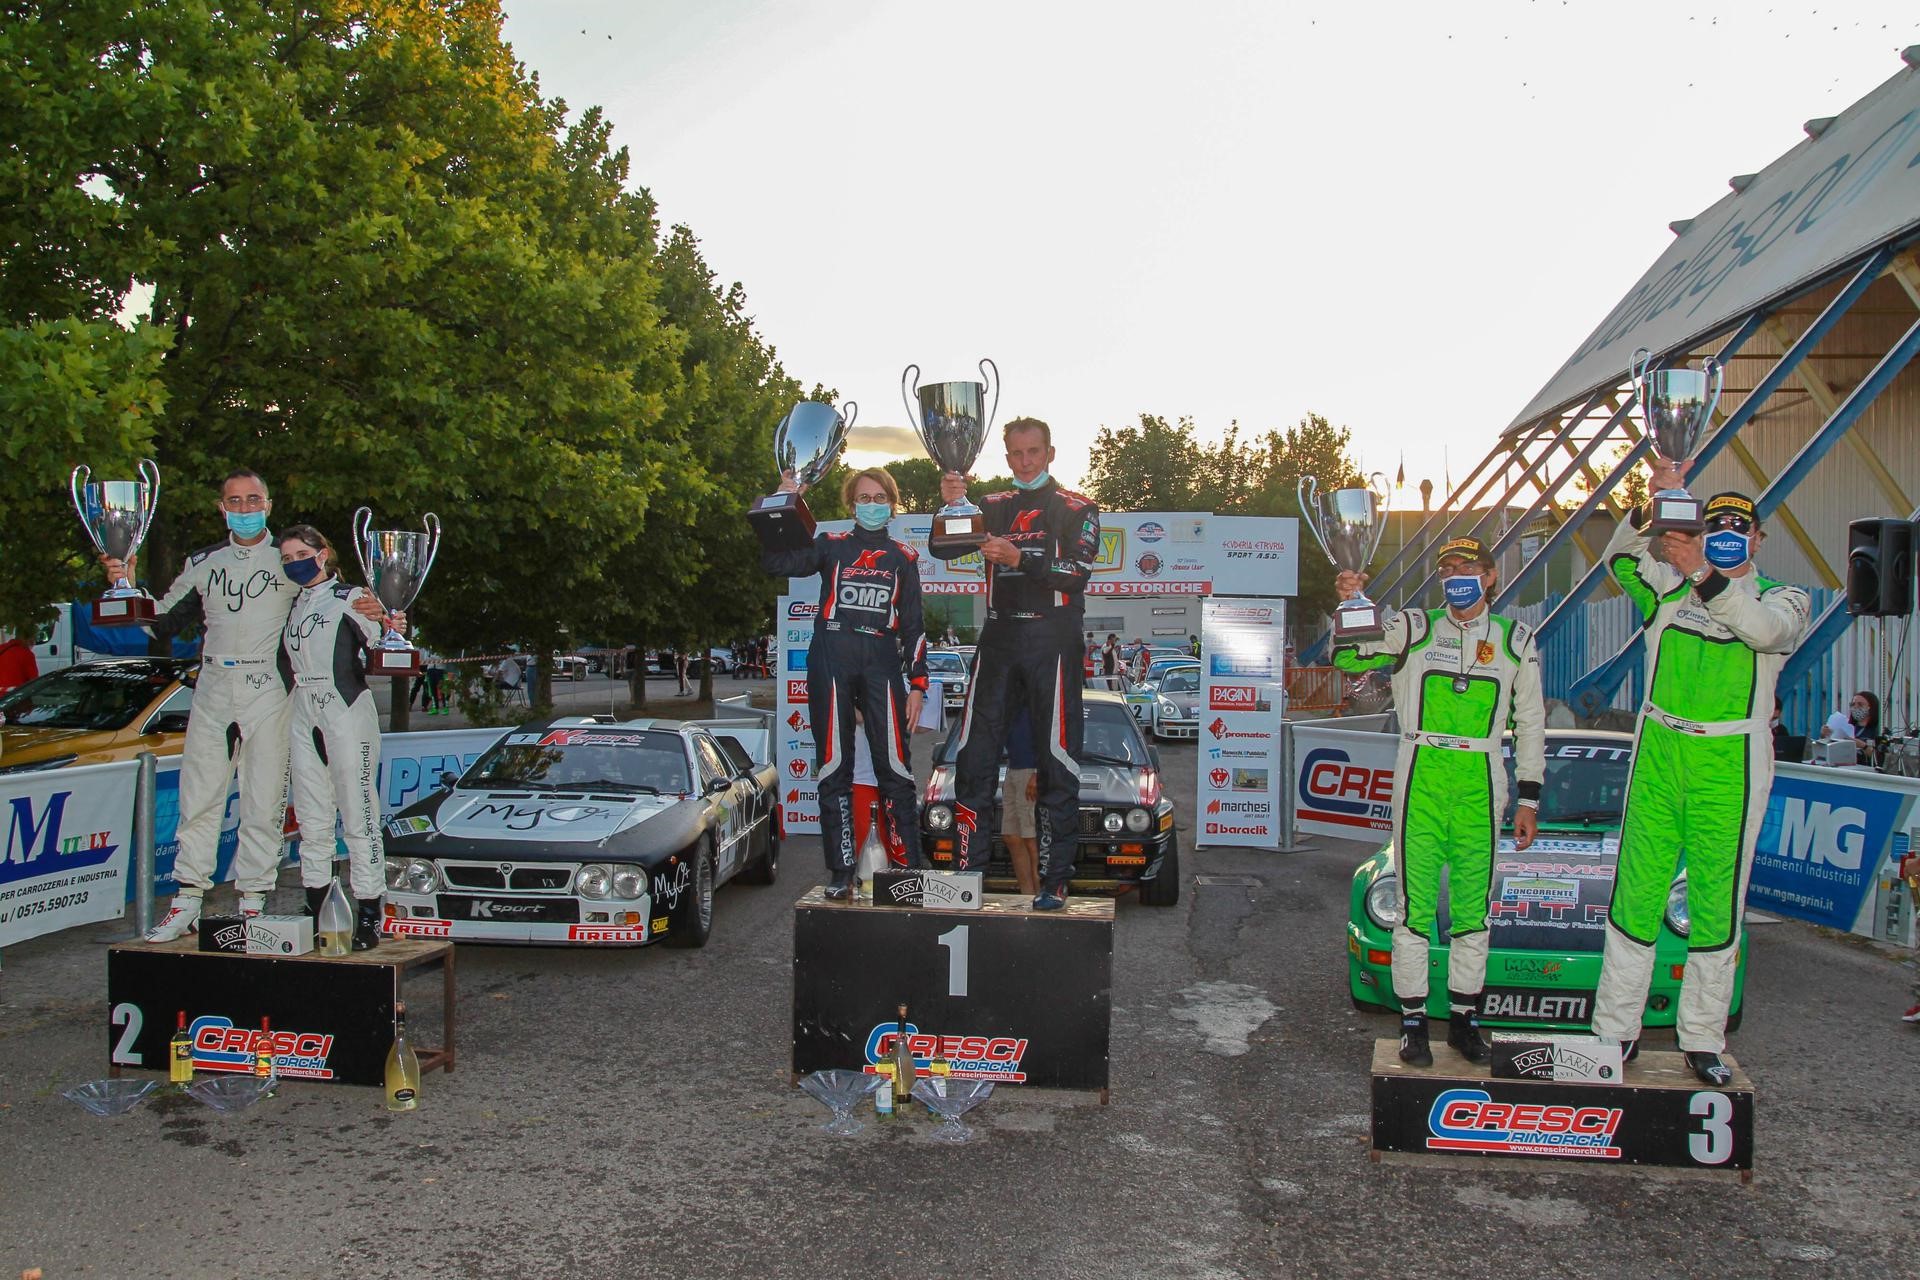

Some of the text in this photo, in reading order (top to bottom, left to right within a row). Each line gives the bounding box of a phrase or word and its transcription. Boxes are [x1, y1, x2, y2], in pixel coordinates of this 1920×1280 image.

[840, 585, 890, 608] OMP
[919, 583, 979, 593] ONATO
[1081, 582, 1203, 594] UTO STORICHE
[1213, 687, 1252, 702] PAGANI
[1134, 705, 1142, 719] 2
[1221, 801, 1270, 813] marchesi
[838, 795, 855, 866] RANGERS
[1220, 824, 1268, 835] baraclit
[1778, 796, 1868, 870] MG
[1755, 855, 1862, 887] edamenti Industriali
[17, 882, 69, 897] CARROZZERIA
[78, 869, 118, 884] INDUSTRIA
[891, 881, 915, 899] FOSS
[1506, 887, 1574, 897] CONCORRENTE
[18, 891, 89, 919] 0575.590733
[383, 917, 453, 937] PIRELLI
[568, 925, 644, 942] PIRELLI
[653, 917, 669, 932] OMP
[1513, 919, 1571, 931] Technology
[215, 928, 239, 946] FOSS
[938, 924, 969, 997] 1
[1484, 994, 1587, 1020] BALLETTI
[112, 1002, 144, 1066] 2
[1513, 1051, 1543, 1071] FOSS
[1543, 1046, 1595, 1074] MARAI
[1440, 1101, 1624, 1136] CRESCI
[1688, 1091, 1735, 1165] 3
[1509, 1132, 1613, 1148] RIMORCHI
[1509, 1143, 1608, 1157] www.crescirimorchi.it
